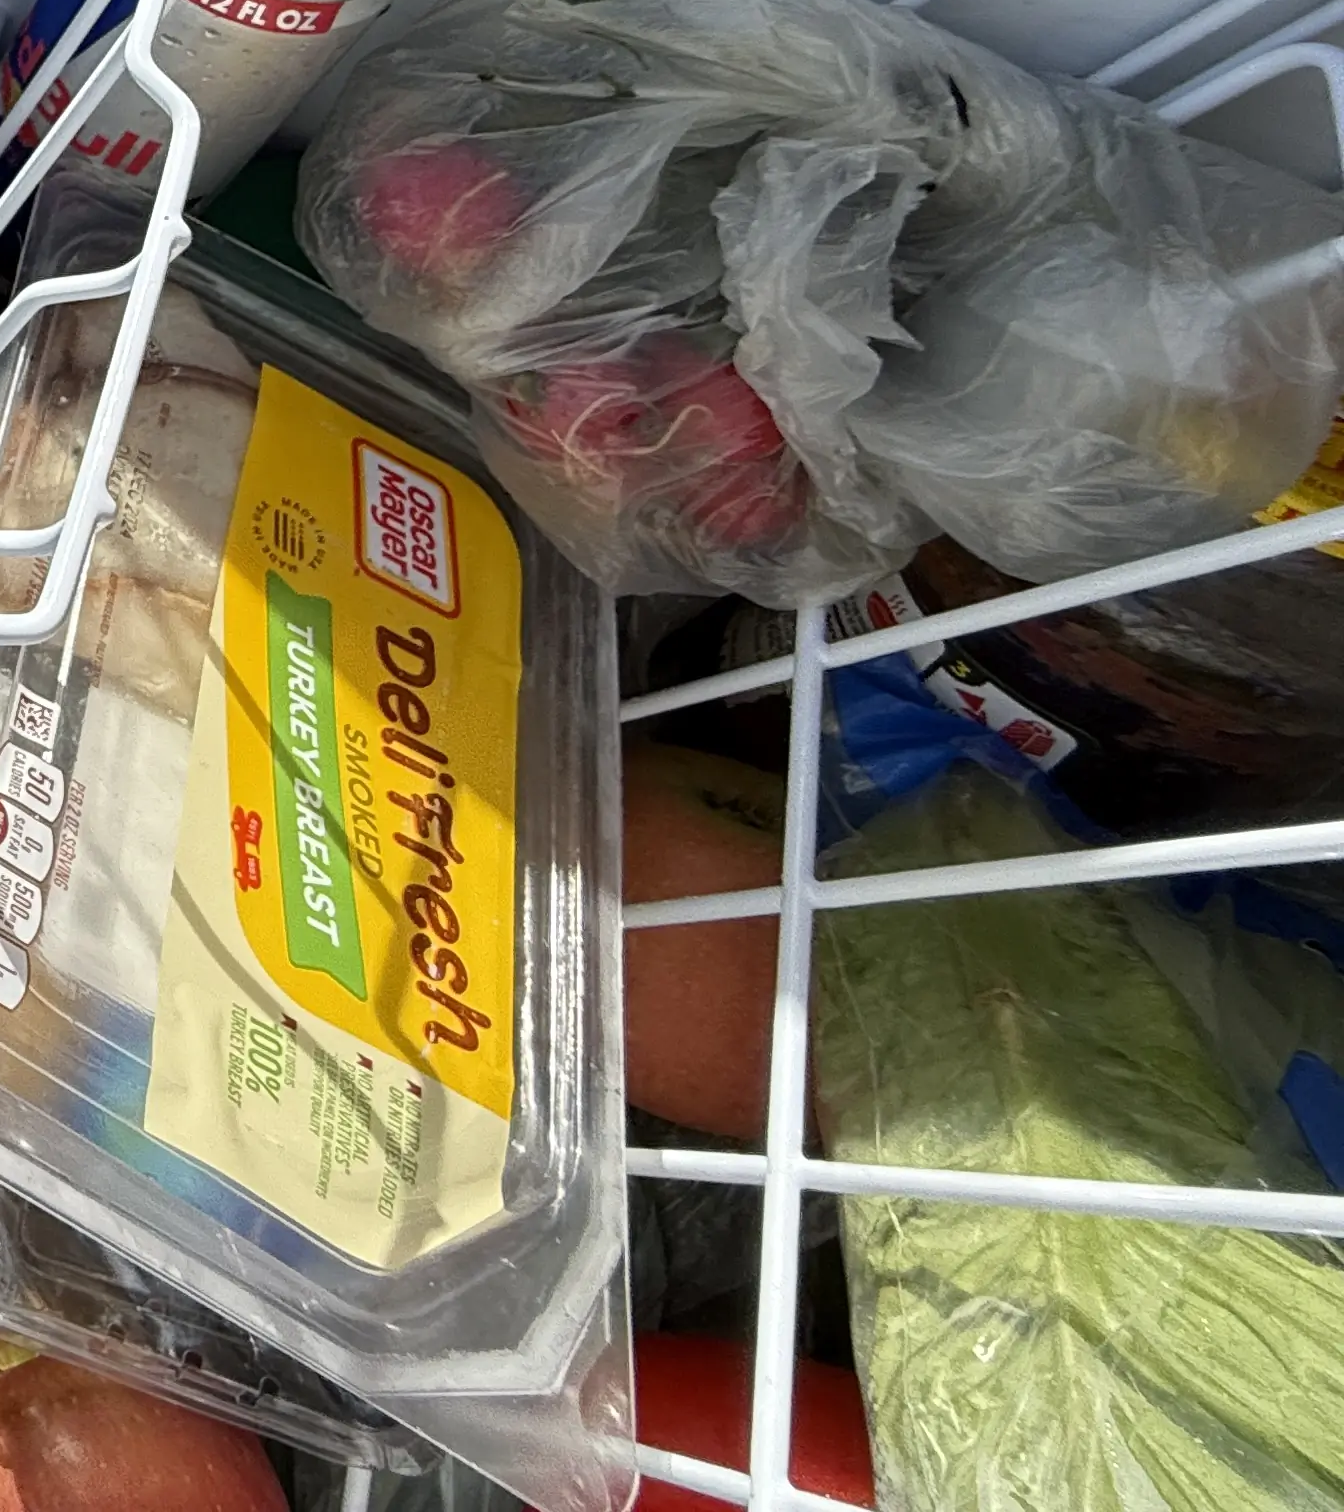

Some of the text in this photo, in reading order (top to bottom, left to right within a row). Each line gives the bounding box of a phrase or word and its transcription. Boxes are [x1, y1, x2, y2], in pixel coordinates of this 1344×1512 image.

[236, 0, 267, 25] FL
[276, 9, 321, 31] OZ
[281, 496, 316, 524] MADE
[314, 529, 325, 544] IN
[372, 464, 409, 578] Mayer
[408, 485, 438, 591] Oscar
[8, 750, 27, 797] CALORIES
[25, 767, 56, 807] 50
[287, 621, 341, 948] TURKEY BREAST
[344, 724, 384, 881] SMOKED
[7, 814, 25, 860] SAT FAT
[54, 779, 87, 891] PER 2 OZ SERVING
[376, 625, 492, 1052] Deli Fresh
[228, 1003, 247, 1108] TURKEY BREAST
[244, 1016, 285, 1104] 100%
[352, 1069, 373, 1165] NO ARTIFICIAL
[378, 1086, 404, 1219] OR NITRITES ADDED
[401, 1096, 421, 1185] NO NITRATES
